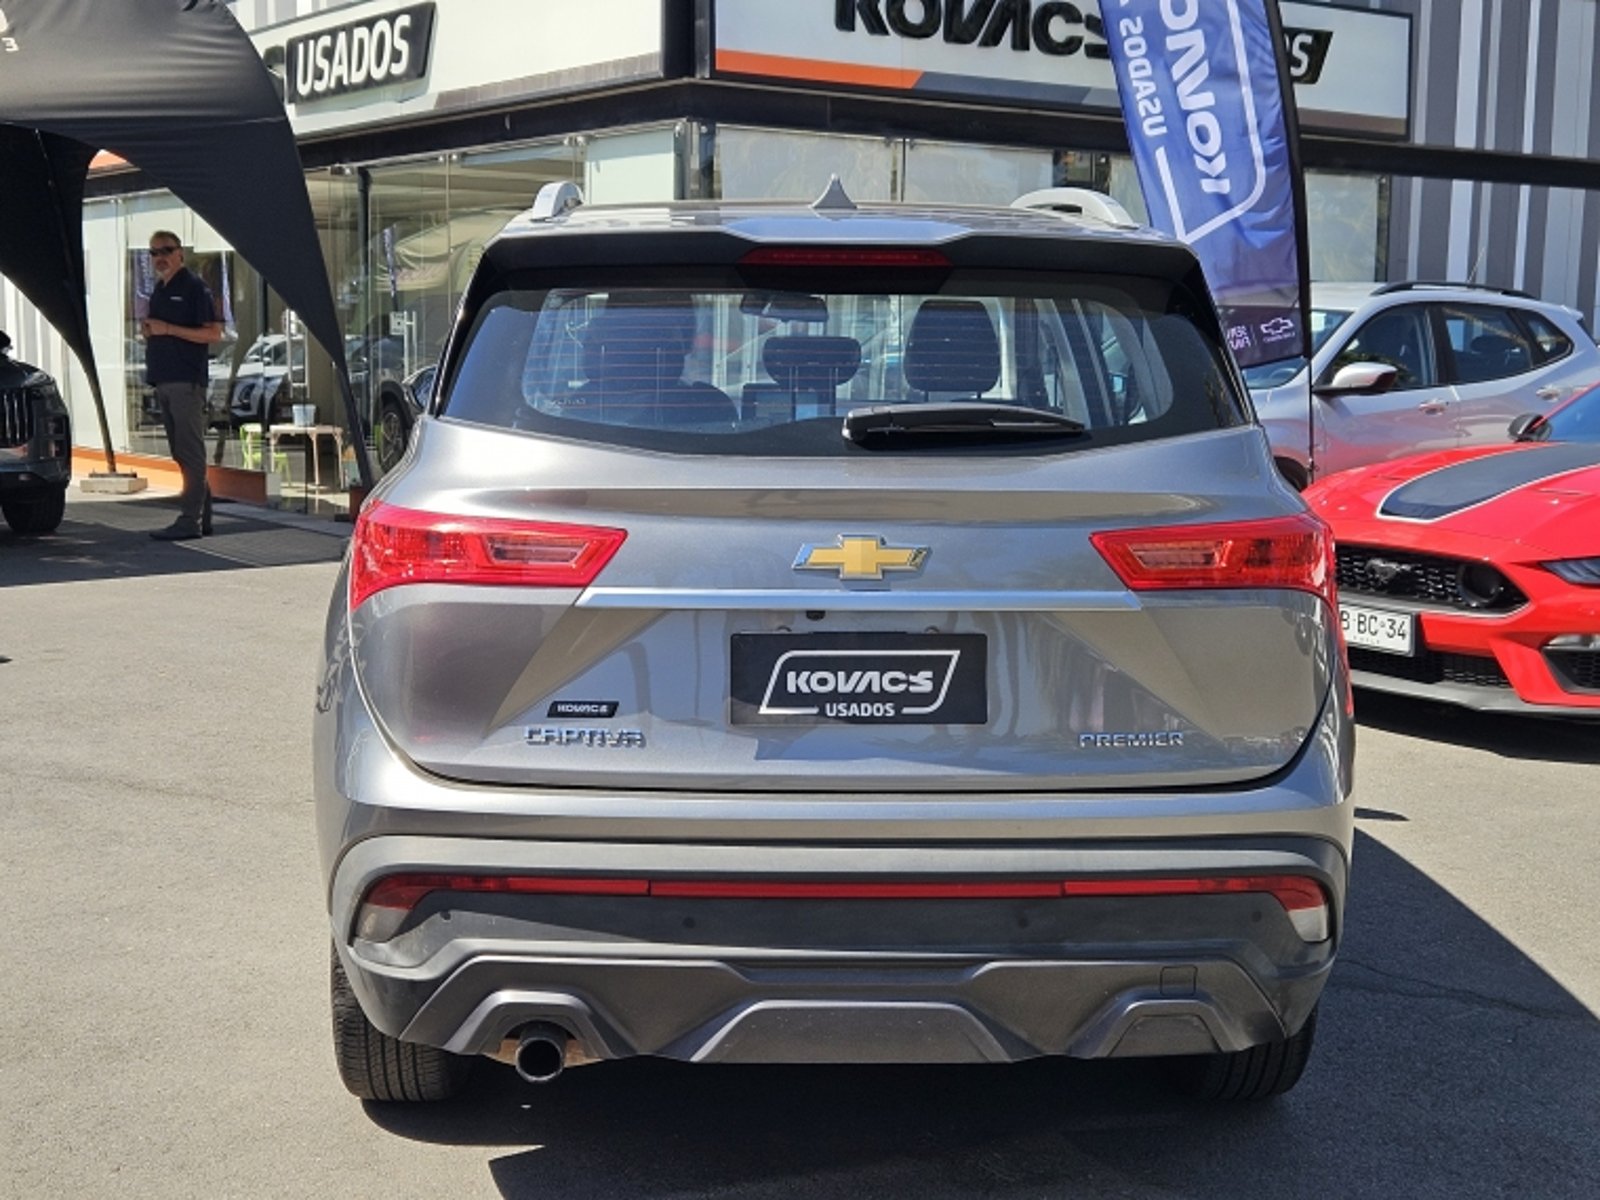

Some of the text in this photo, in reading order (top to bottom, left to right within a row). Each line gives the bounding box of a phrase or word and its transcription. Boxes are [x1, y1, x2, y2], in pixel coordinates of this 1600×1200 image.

[296, 14, 411, 96] USADOS
[786, 671, 934, 693] KOVACS
[825, 702, 895, 717] USADOS
[524, 726, 647, 748] CAPTIVA
[1079, 732, 1184, 748] PREMIER
